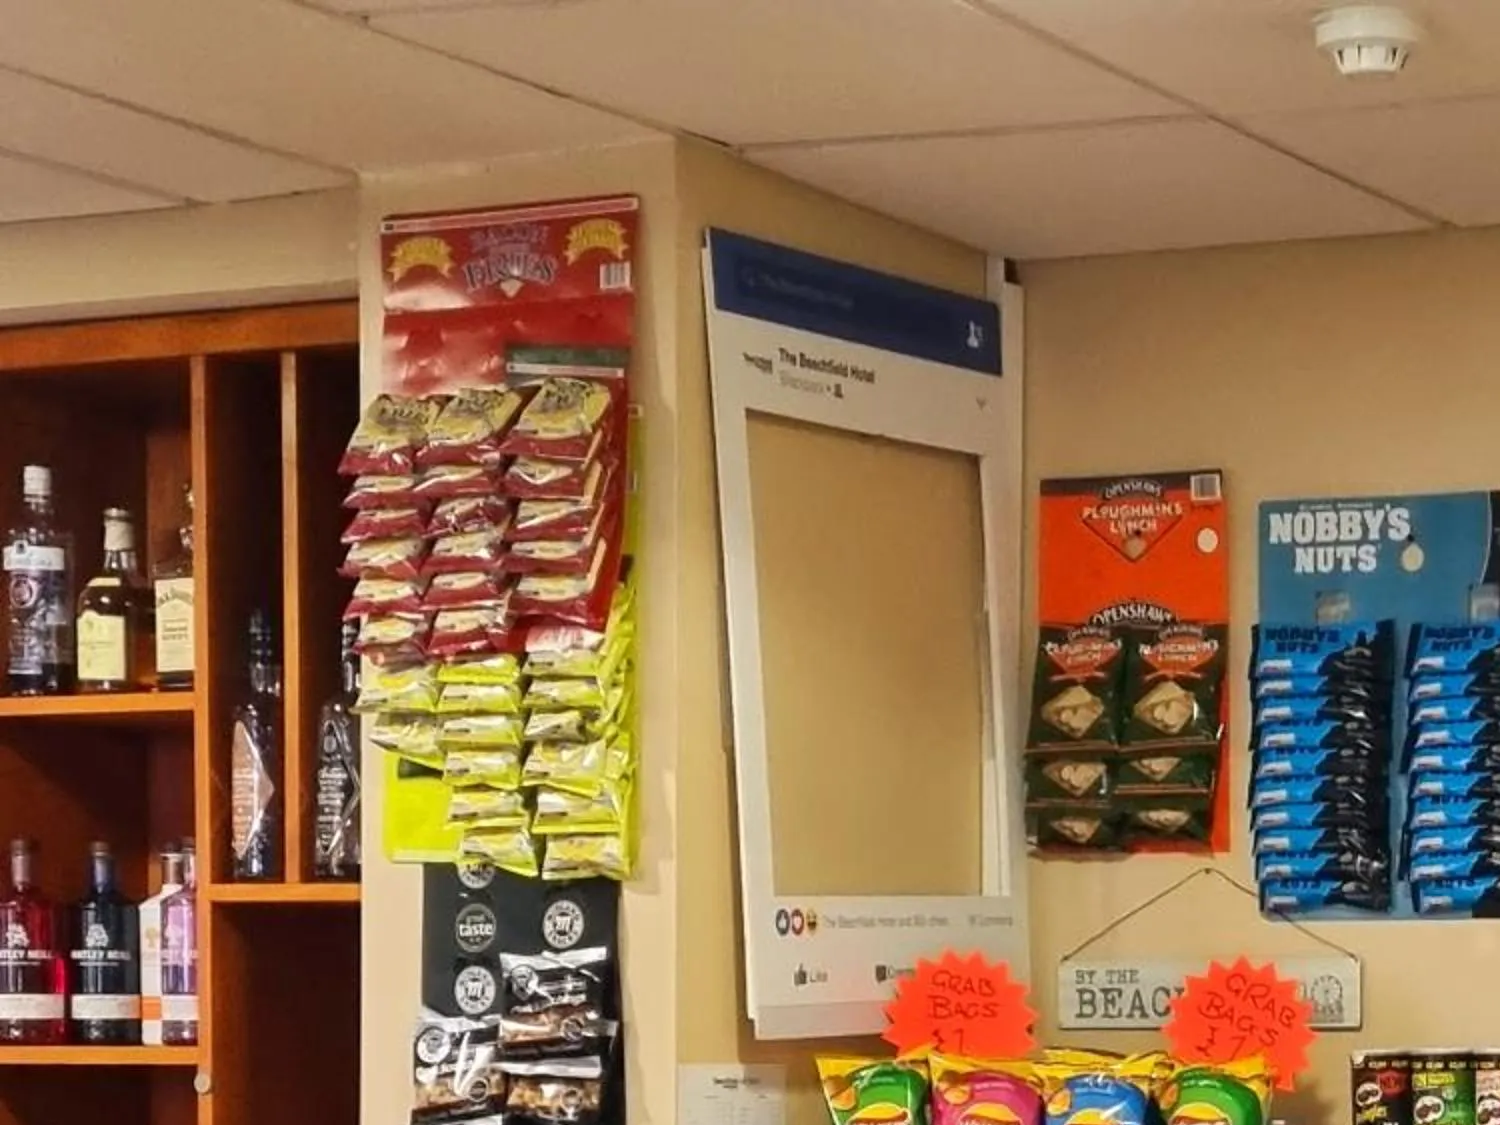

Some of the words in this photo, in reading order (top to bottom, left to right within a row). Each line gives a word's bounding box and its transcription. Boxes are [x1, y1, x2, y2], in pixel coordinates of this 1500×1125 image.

[778, 347, 797, 367] The
[1109, 519, 1158, 536] LUNCH
[1268, 503, 1412, 545] NOBBY'S
[1293, 544, 1379, 574] NUTS
[458, 922, 494, 937] taste
[931, 970, 996, 997] GRAB
[1074, 970, 1097, 985] BY
[1105, 968, 1140, 984] THE
[928, 994, 1000, 1020] BAGS
[1075, 985, 1186, 1019] BEAC
[1225, 972, 1297, 1029] GRAB
[1197, 991, 1279, 1047] BAGS
